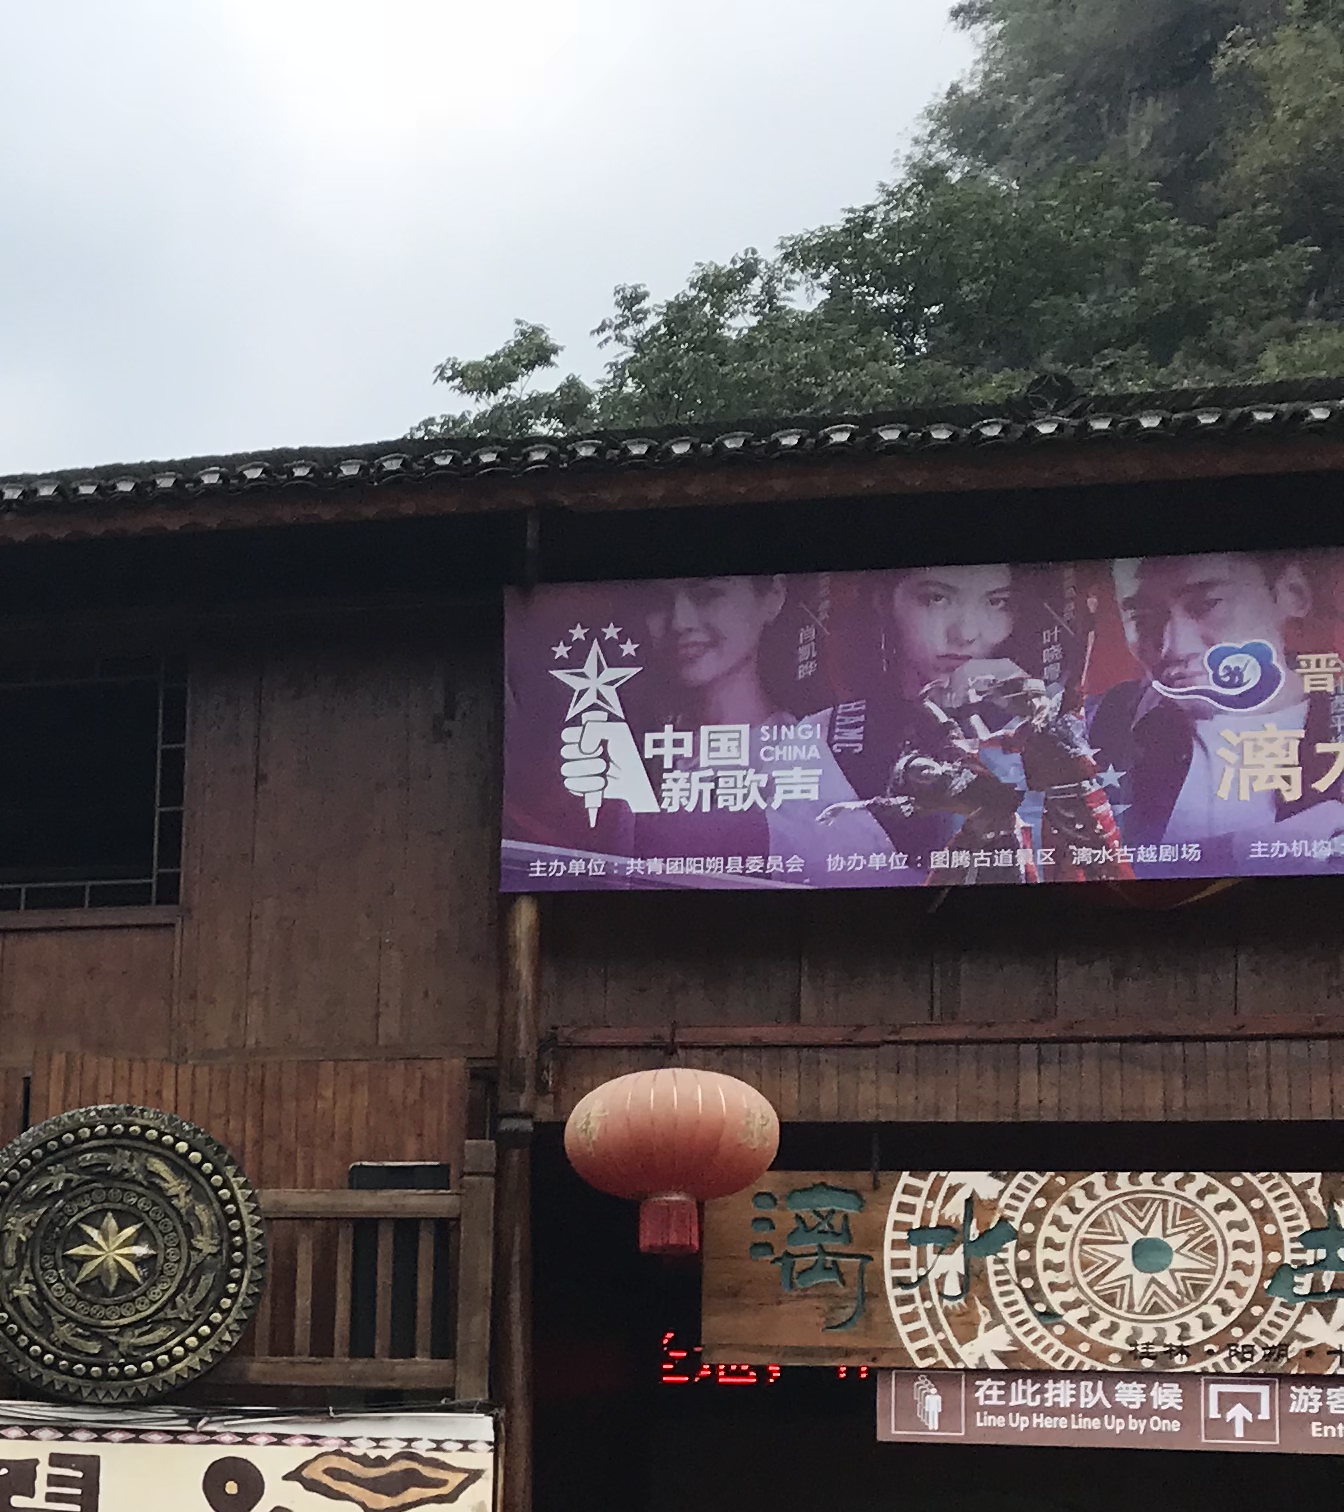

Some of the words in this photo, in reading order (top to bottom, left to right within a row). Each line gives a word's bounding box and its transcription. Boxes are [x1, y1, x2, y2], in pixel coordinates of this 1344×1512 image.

[1295, 652, 1344, 693] 晋
[644, 724, 750, 769] 中国
[759, 744, 821, 762] CHINA
[660, 767, 823, 813] 新歌声
[974, 1378, 1183, 1411] 在此排队等候
[976, 1412, 1006, 1427] Line
[1009, 1412, 1029, 1431] Up
[1033, 1413, 1068, 1430] Here
[1071, 1414, 1101, 1430] Line
[1104, 1414, 1125, 1434] Up
[1129, 1415, 1146, 1434] by
[1150, 1416, 1182, 1432] One
